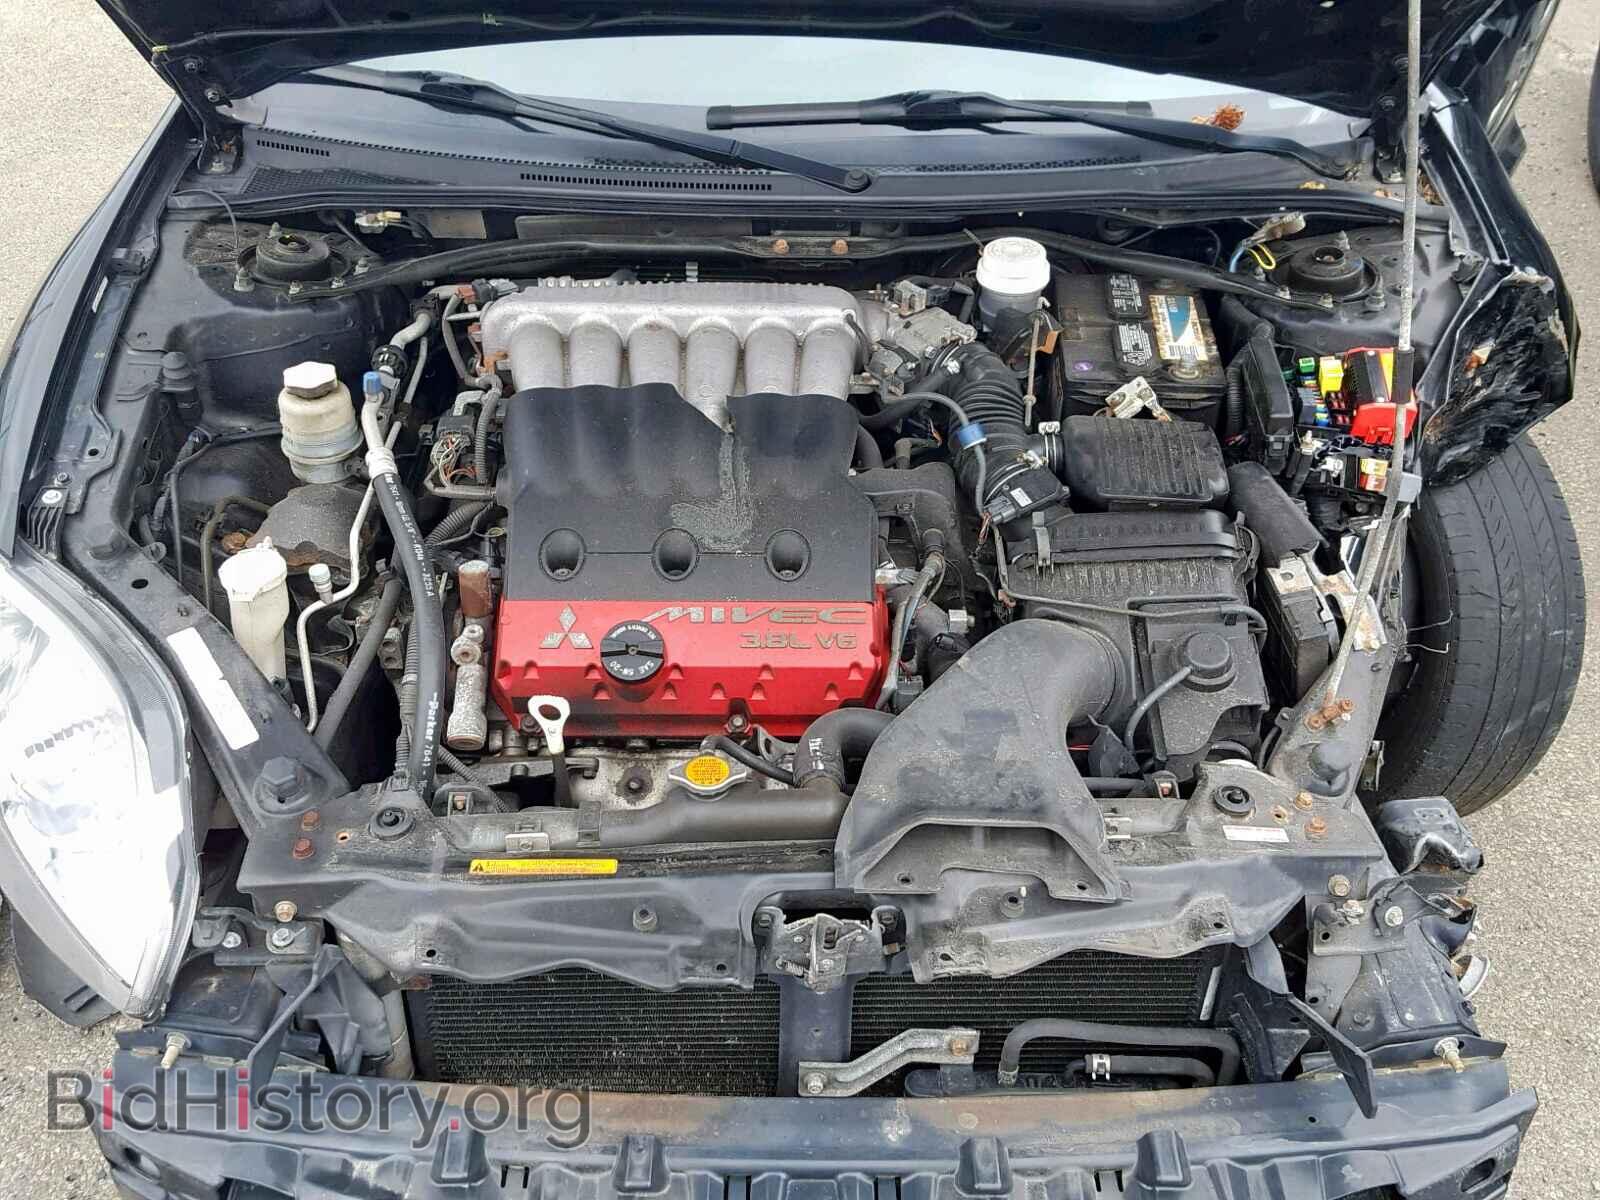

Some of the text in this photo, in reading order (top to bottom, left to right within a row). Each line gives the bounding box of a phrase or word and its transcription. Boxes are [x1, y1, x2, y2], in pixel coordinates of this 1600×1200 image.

[641, 605, 867, 624] MIVEC
[739, 632, 858, 649] 3.8L V6
[424, 701, 438, 741] Parker
